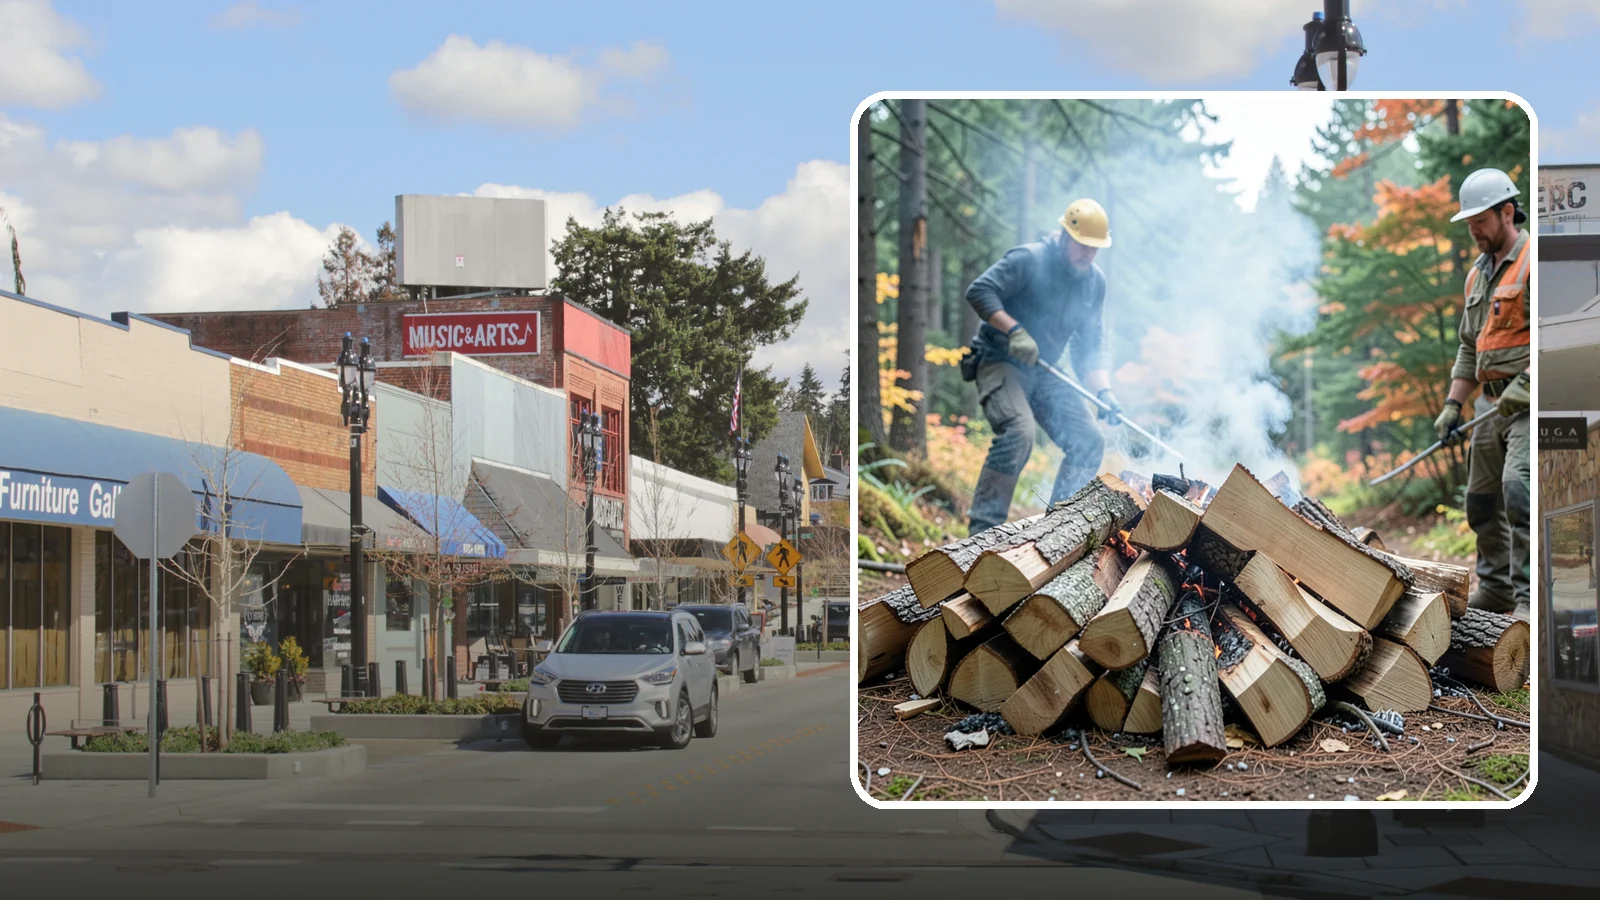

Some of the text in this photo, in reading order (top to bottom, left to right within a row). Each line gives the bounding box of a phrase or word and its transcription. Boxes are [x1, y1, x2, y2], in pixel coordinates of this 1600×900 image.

[409, 323, 519, 349] MUSIC&ARTS
[0, 471, 122, 519] Furniture Gal
[452, 563, 480, 574] SUSHI
